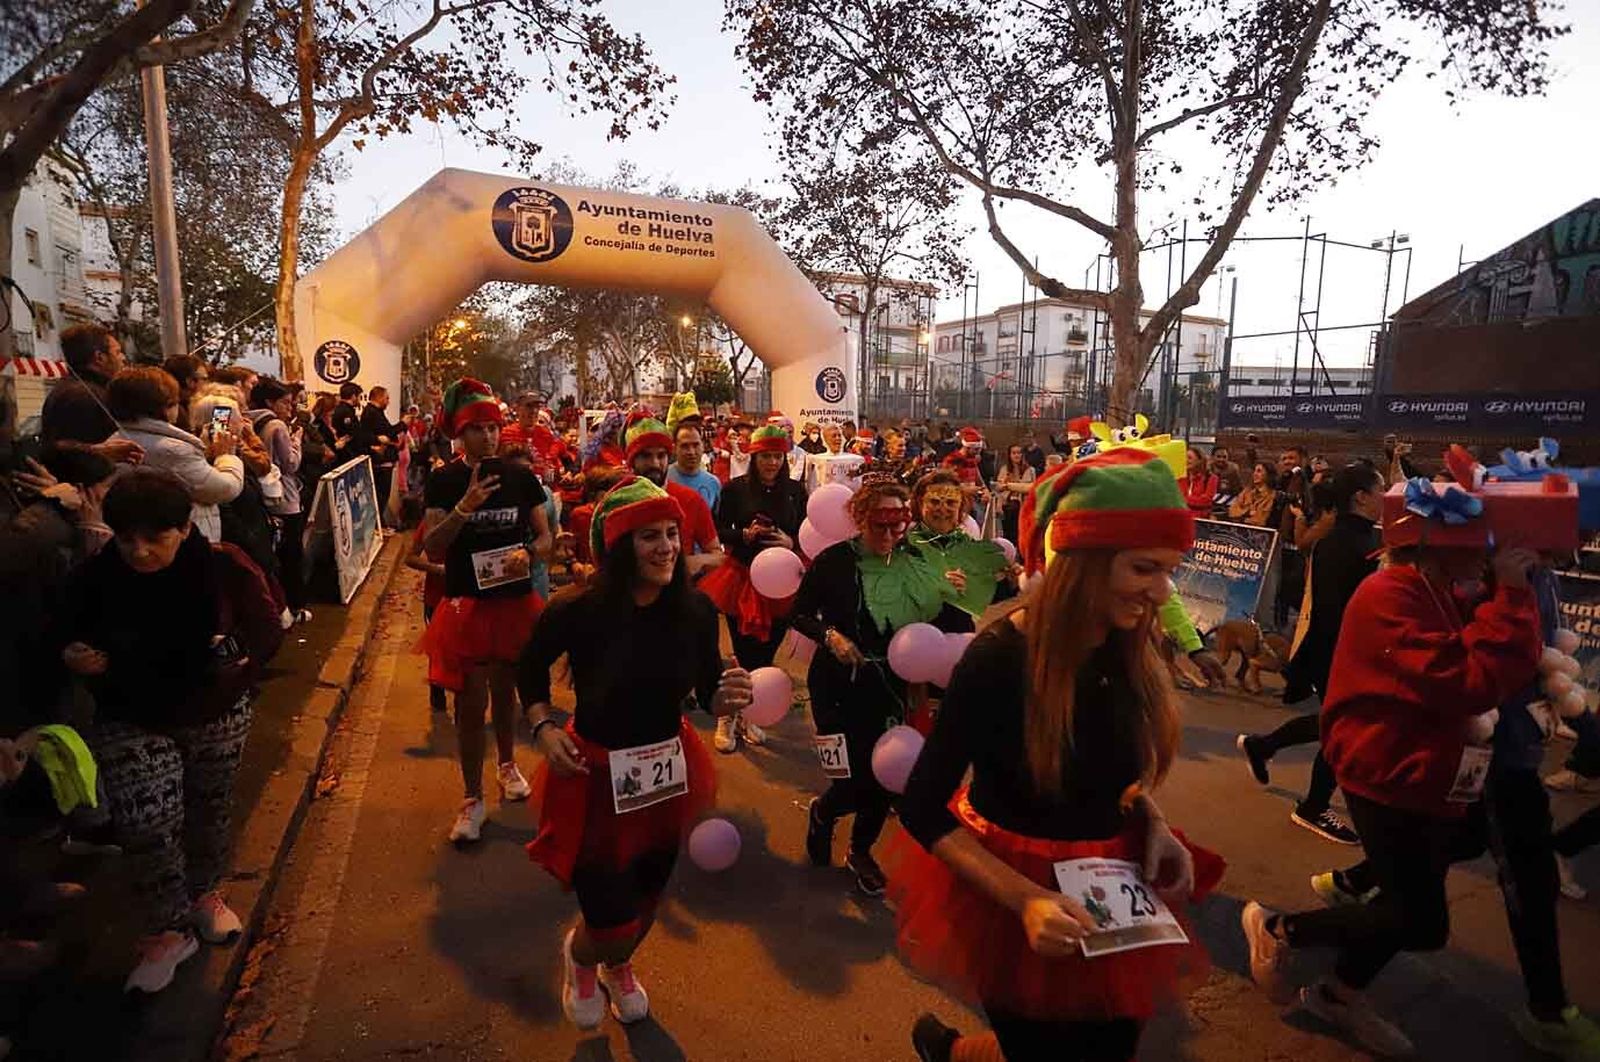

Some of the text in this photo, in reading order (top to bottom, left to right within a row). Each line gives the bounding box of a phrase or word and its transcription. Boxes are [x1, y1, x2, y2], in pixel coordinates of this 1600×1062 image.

[577, 200, 713, 227] Ayuntamiento
[618, 221, 713, 244] de Huelva
[648, 241, 662, 253] de
[665, 243, 715, 258] Deportes
[1246, 403, 1287, 412] HYUNDAI
[1315, 402, 1362, 413] HYUNDAI
[1410, 402, 1469, 413] HYUNDAI
[1513, 401, 1585, 413] HYUNDAI
[1195, 550, 1211, 562] de
[1213, 553, 1259, 573] Huelva
[652, 758, 673, 787] 21
[1120, 883, 1157, 917] 23
